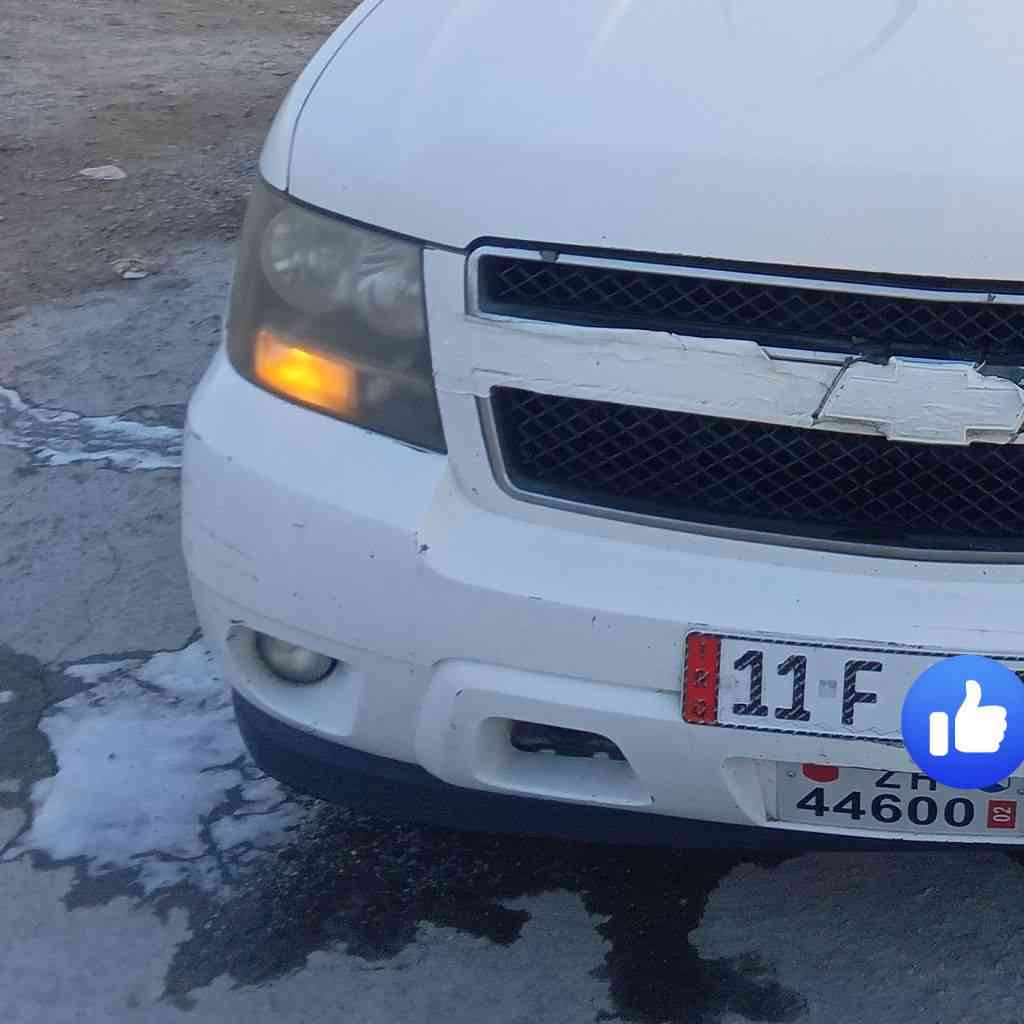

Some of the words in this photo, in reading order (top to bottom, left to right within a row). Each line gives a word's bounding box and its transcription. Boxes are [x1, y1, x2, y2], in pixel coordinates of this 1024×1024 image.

[732, 649, 811, 721] 11
[841, 660, 883, 725] F
[796, 787, 975, 827] 44600
